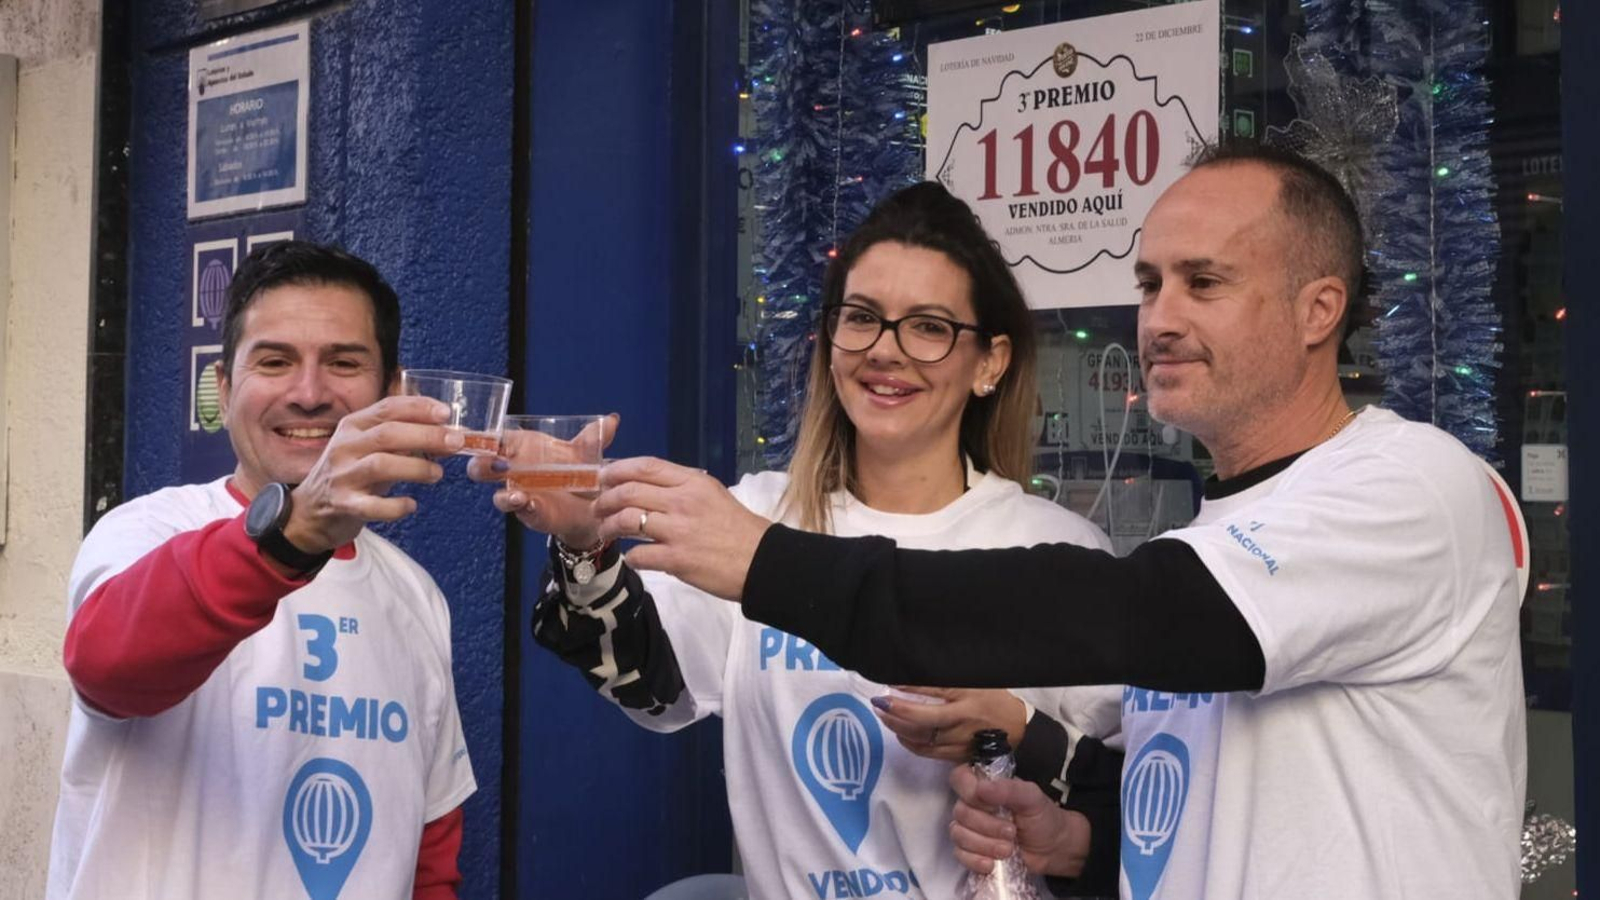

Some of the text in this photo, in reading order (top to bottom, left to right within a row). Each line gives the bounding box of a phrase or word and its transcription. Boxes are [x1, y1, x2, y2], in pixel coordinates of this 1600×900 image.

[1145, 31, 1156, 40] DE
[1158, 24, 1203, 39] DICIEMBRE
[970, 59, 980, 68] DE
[982, 52, 1015, 65] NAVIDAD
[1033, 80, 1116, 110] PREMIO
[976, 109, 1160, 201] 11840
[1522, 155, 1562, 176] LOTE
[1008, 189, 1123, 219] VENDIDO AQUÍ
[1101, 217, 1127, 228] SALUD
[256, 686, 409, 744] PREMIO
